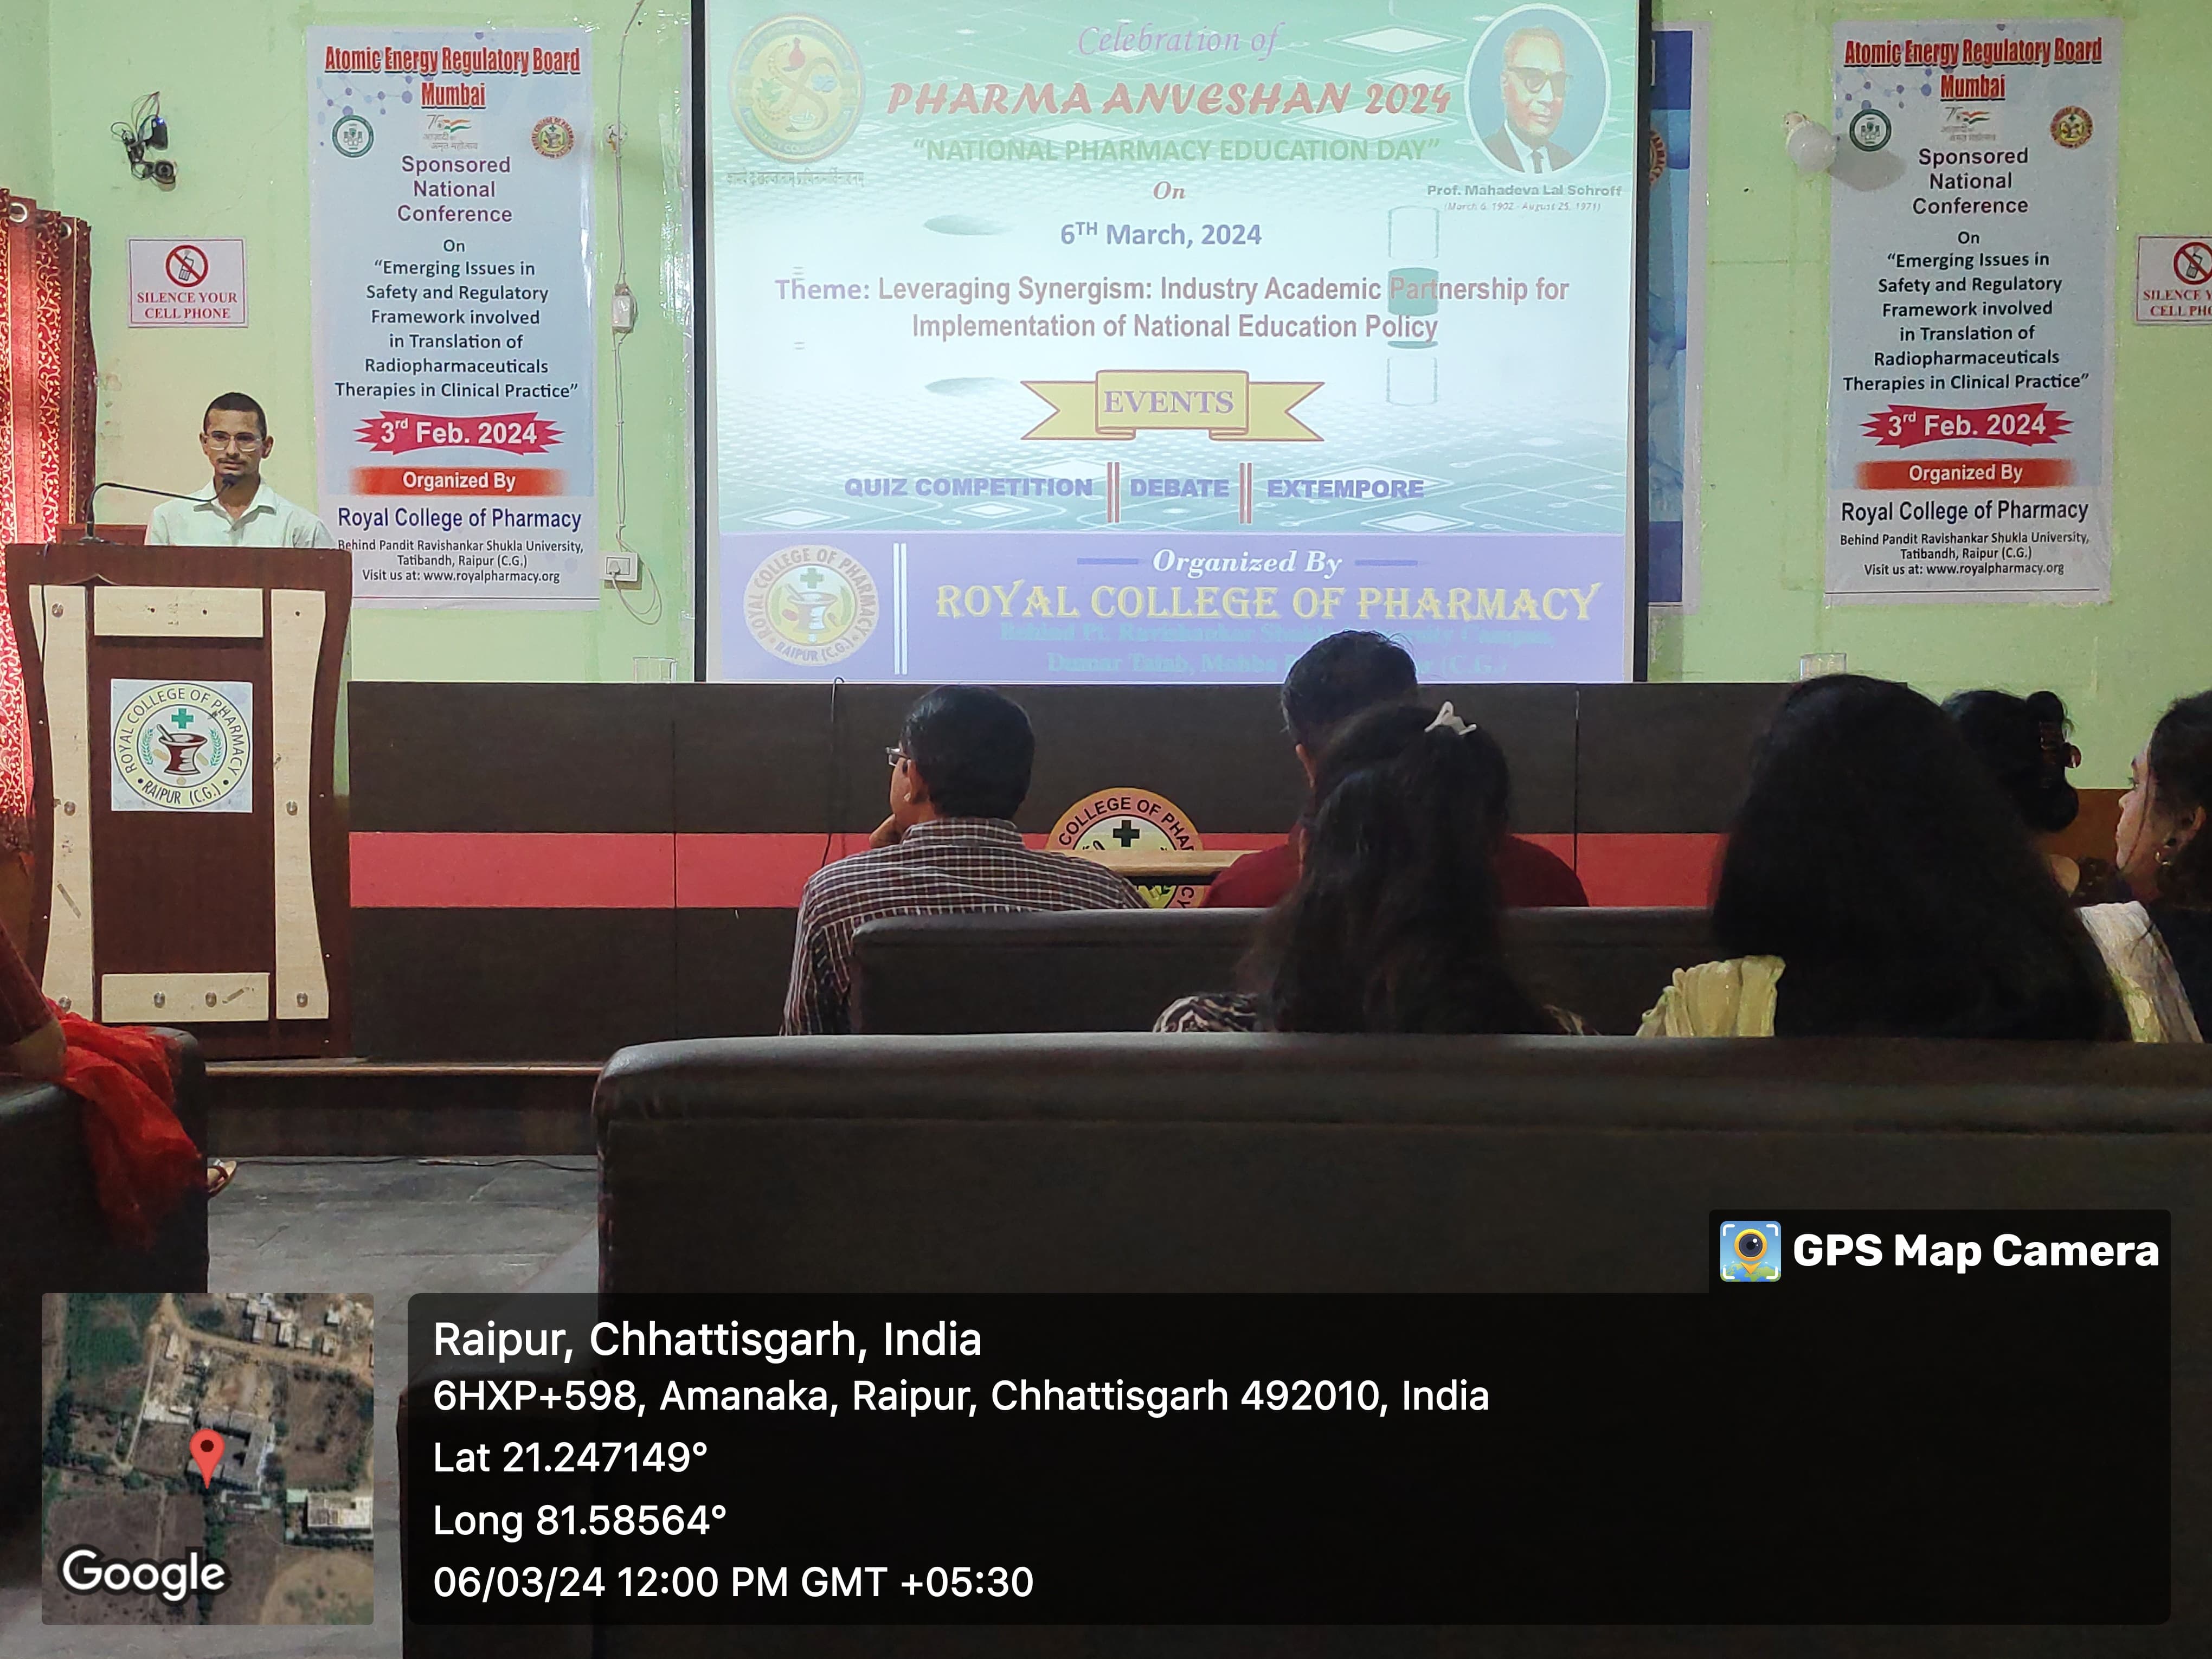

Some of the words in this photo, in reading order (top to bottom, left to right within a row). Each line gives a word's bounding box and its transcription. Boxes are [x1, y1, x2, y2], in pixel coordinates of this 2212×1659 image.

[1078, 21, 1240, 55] Celebration
[1250, 23, 1280, 61] of
[325, 46, 381, 72] Atomic
[384, 46, 438, 74] Energy
[441, 47, 529, 75] Regulatory
[532, 48, 580, 72] Board
[1845, 40, 1901, 64] Atomic
[1905, 40, 1959, 66] Energy
[1963, 38, 2050, 66] Regulatory
[2054, 37, 2101, 63] Board
[421, 82, 485, 106] Mumbai
[1941, 74, 2005, 99] Mumbai
[887, 82, 1092, 115] PHARMA
[1101, 82, 1352, 115] ANVESHAN
[1365, 82, 1452, 115] 2024
[914, 139, 1059, 161] “NATIONAL
[1065, 139, 1213, 161] PHARMACY
[1221, 139, 1368, 162] EDUCATION
[1375, 138, 1439, 162] DAY”
[1919, 147, 2028, 168] Sponsored
[401, 156, 511, 176] Sponsored
[414, 181, 495, 197] National
[1930, 171, 2012, 189] National
[1153, 182, 1185, 200] On
[1427, 185, 1461, 196] Prof.
[1465, 185, 1540, 196] Mahadeva
[1544, 185, 1563, 196] Lal
[397, 205, 512, 222] Conference
[1913, 197, 2028, 214] Conference
[1060, 222, 1097, 245] 6TH
[1107, 222, 1194, 248] March,
[1201, 224, 1262, 245] 2024
[1958, 232, 1979, 244] On
[443, 240, 465, 252] On
[374, 259, 460, 277] “Emerging
[466, 261, 515, 275] Issues
[520, 262, 535, 275] in
[366, 285, 417, 303] Safety
[423, 286, 453, 299] and
[459, 286, 549, 303] Regulatory
[775, 279, 870, 300] Theme:
[879, 277, 1010, 305] Leveraging
[1018, 277, 1152, 305] Synergism:
[1161, 277, 1257, 305] Industry
[1265, 277, 1382, 301] Academic
[1391, 278, 1528, 305] Partnership
[1535, 277, 1568, 301] for
[1879, 278, 1930, 294] Safety
[1936, 278, 1966, 291] and
[1972, 277, 2062, 293] Regulatory
[2144, 290, 2200, 300] SILENCE
[137, 292, 196, 303] SILENCE
[198, 292, 237, 303] YOUR
[145, 308, 181, 319] CELL
[184, 308, 230, 319] PHONE
[371, 310, 464, 324] Framework
[471, 310, 539, 324] involved
[1882, 303, 1977, 317] Framework
[1983, 301, 2053, 316] involved
[2150, 306, 2187, 316] CELL
[914, 314, 1095, 342] Implementation
[1103, 314, 1126, 336] of
[1134, 314, 1230, 337] National
[1239, 316, 1356, 338] Education
[1366, 316, 1438, 342] Policy
[365, 359, 548, 376] Radiopharmaceuticals
[1874, 350, 2060, 368] Radiopharmaceuticals
[336, 383, 415, 400] Therapies
[421, 383, 435, 397] in
[441, 383, 499, 397] Clinical
[505, 383, 577, 398] Practice”
[1104, 391, 1234, 414] EVENTS
[381, 418, 408, 443] 3rd
[417, 422, 470, 443] Feb.
[478, 422, 537, 443] 2024
[403, 472, 487, 490] Organized
[494, 473, 516, 492] By
[845, 478, 907, 497] QUIZ
[916, 478, 1092, 497] COMPETITION
[1130, 479, 1229, 498] DEBATE
[1268, 479, 1424, 498] EXTEMPORE
[339, 507, 388, 531] Royal
[395, 509, 462, 531] College
[469, 508, 486, 526] of
[492, 509, 581, 532] Pharmacy
[1842, 502, 1892, 526] Royal
[1900, 501, 1967, 524] College
[1974, 500, 1992, 519] of
[1998, 500, 2088, 522] Pharmacy
[339, 539, 376, 550] Behind
[380, 540, 414, 551] Pandit
[417, 540, 484, 552] Ravishankar
[486, 541, 522, 552] Shukla
[526, 541, 583, 554] University,
[1841, 535, 1879, 545] Behind
[1883, 534, 1918, 545] Pandit
[1921, 533, 1988, 544] Ravishankar
[1991, 532, 2028, 543] Shukla
[2031, 531, 2089, 544] University,
[397, 555, 455, 568] Tatibandh,
[459, 556, 494, 568] Raipur
[497, 555, 528, 568] (C.G.)
[817, 549, 837, 564] OF
[1154, 548, 1296, 578] Organized
[1305, 550, 1342, 578] By
[1901, 549, 1959, 561] Tatibandh,
[1963, 548, 1998, 561] Raipur
[2002, 548, 2033, 561] (C.G.)
[363, 570, 387, 581] Visit
[390, 573, 403, 582] us
[406, 571, 420, 582] at:
[423, 571, 560, 584] www.royalpharmacy.org
[754, 548, 810, 588] COLLEGE
[838, 558, 876, 636] PHARMACY
[937, 580, 1078, 620] ROYAL
[1091, 586, 1278, 619] COLLEGE
[1293, 586, 1345, 620] OF
[1358, 582, 1601, 622] PHARMACY
[748, 594, 772, 639] ROYAL
[127, 688, 185, 724] COLLEGE
[190, 690, 210, 703] OF
[210, 699, 245, 776] PHARMACY
[119, 728, 137, 774] ROYAL
[142, 780, 181, 804] RAIPUR
[190, 783, 221, 805] (C.G.)
[1059, 797, 1131, 846] COLLEGE
[1137, 799, 1161, 816] OF
